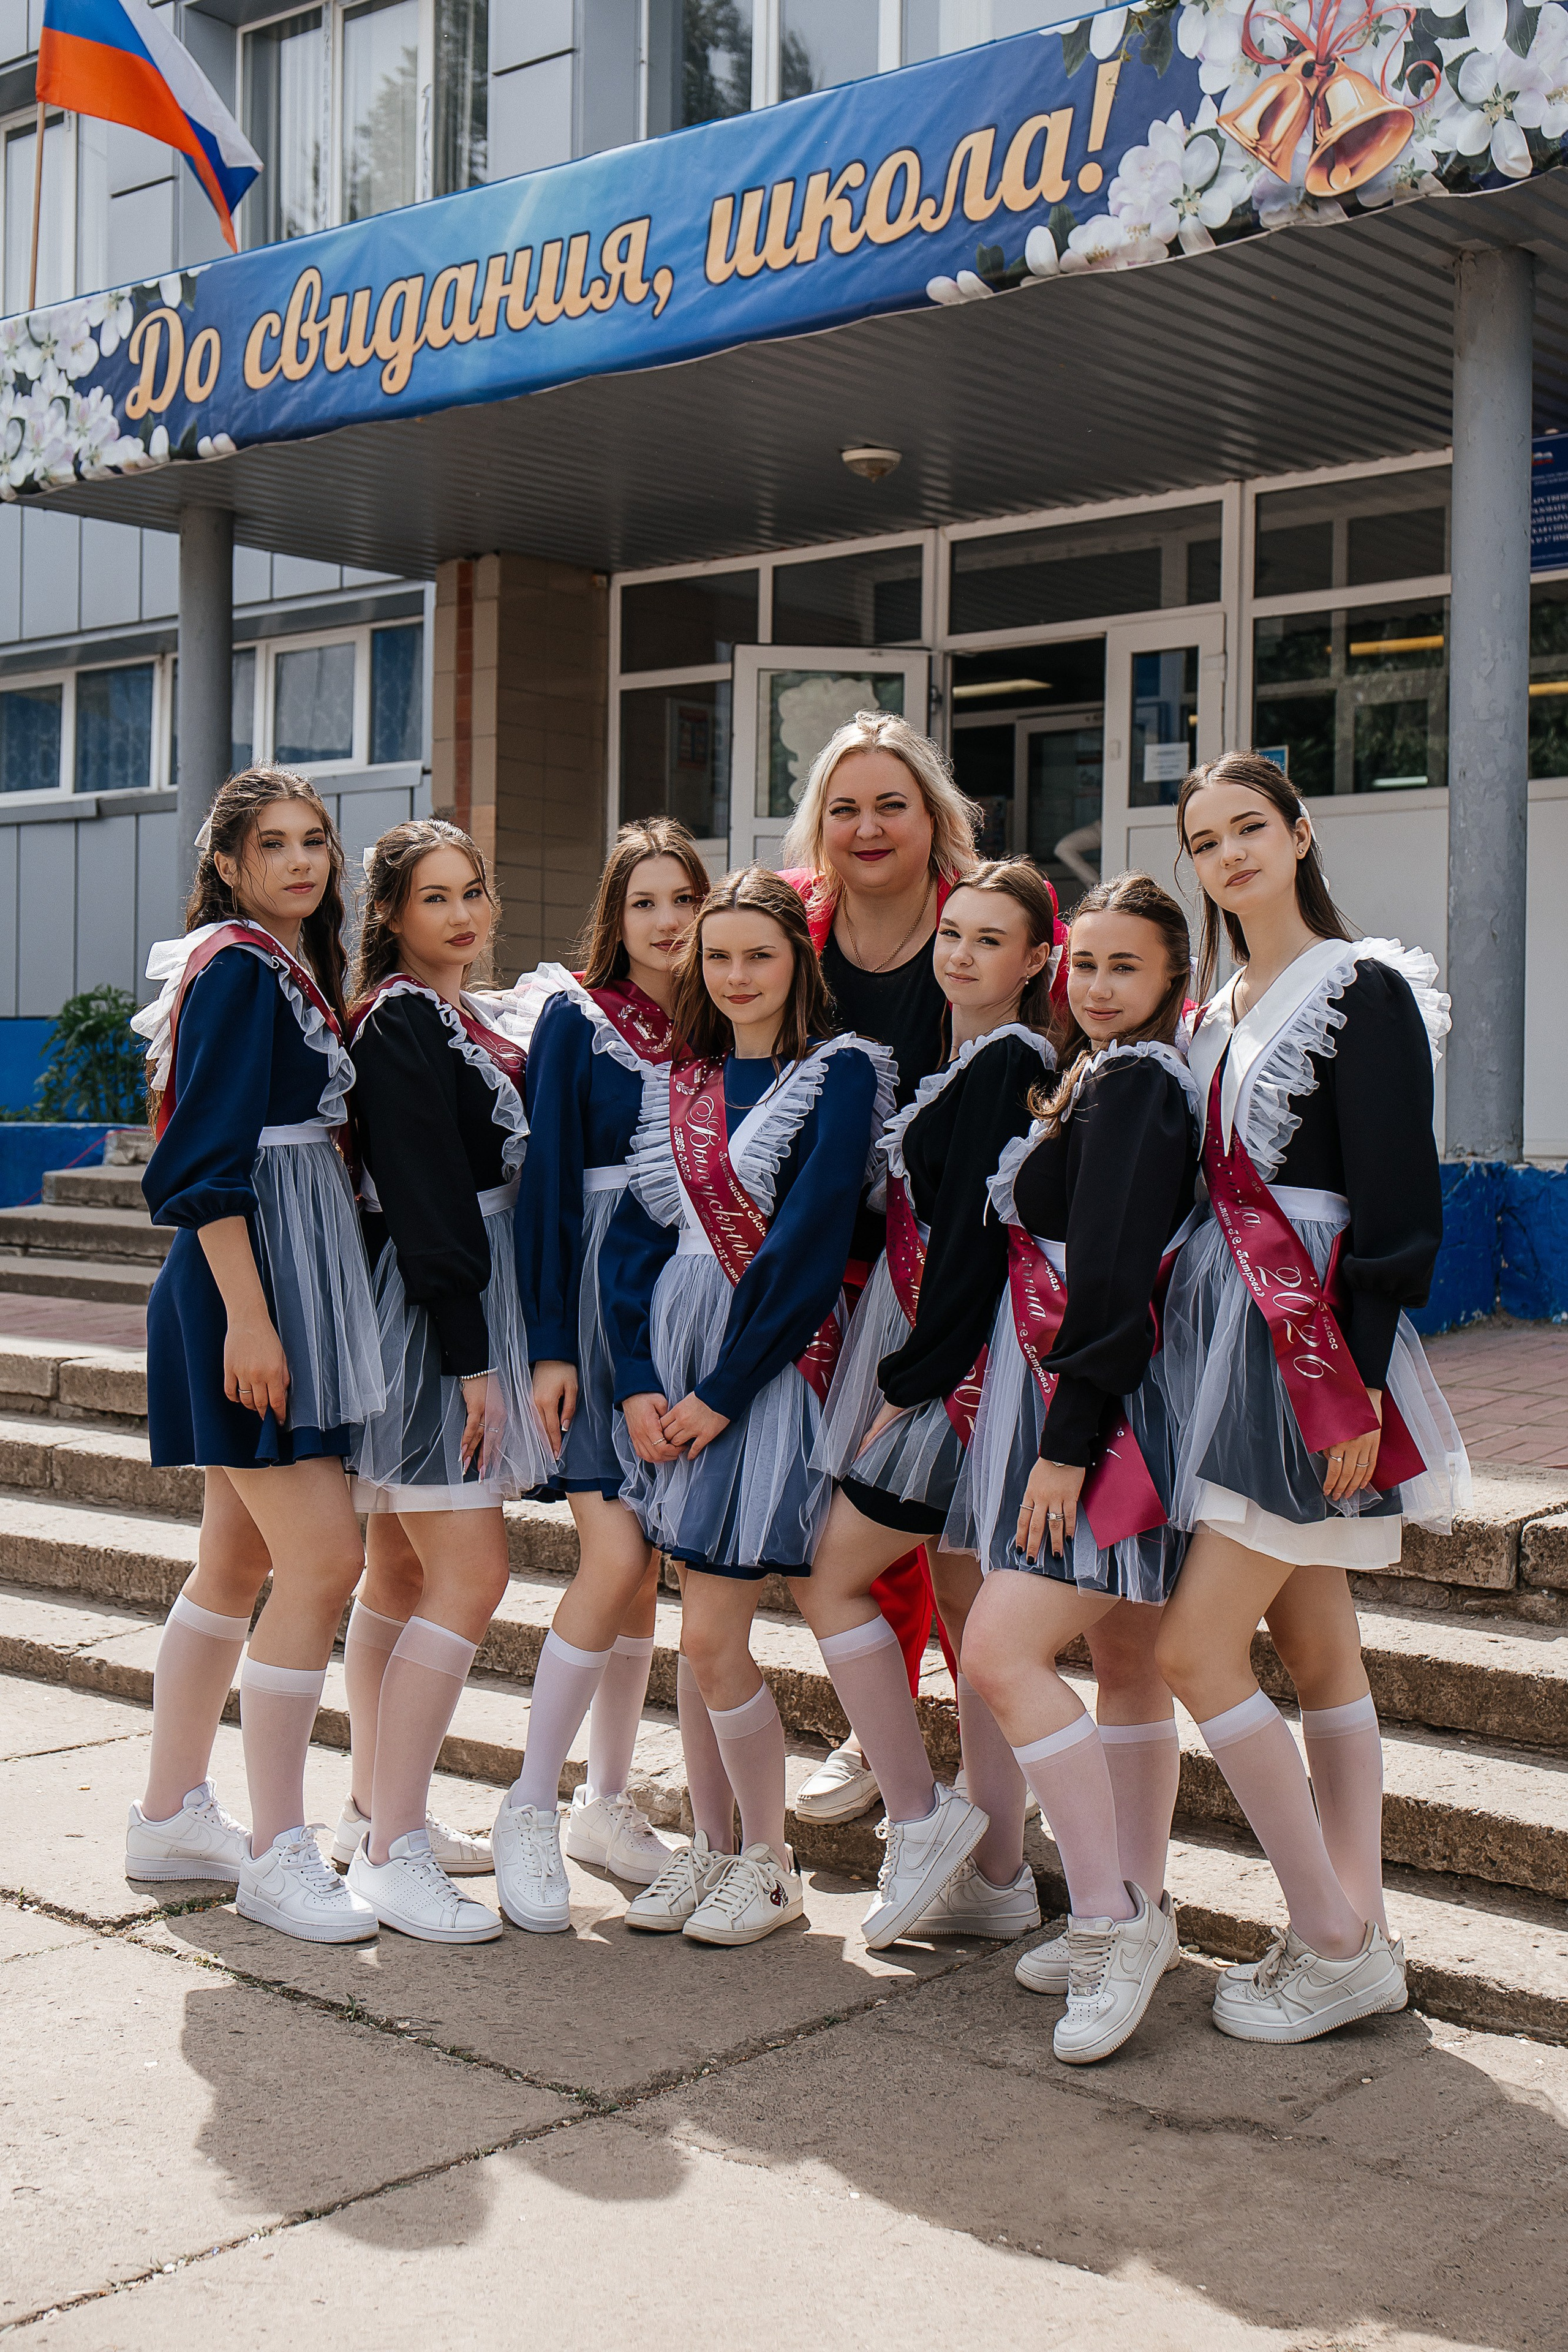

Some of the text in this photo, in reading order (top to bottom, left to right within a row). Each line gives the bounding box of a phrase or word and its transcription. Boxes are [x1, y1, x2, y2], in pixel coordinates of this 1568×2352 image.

[125, 59, 1122, 420] До свидания, школа!
[673, 1126, 686, 1152] ГБОУ
[718, 1151, 750, 1210] Анастасия
[1218, 1200, 1232, 1227] имени
[1236, 1251, 1265, 1297] Петрова»
[1256, 1266, 1338, 1379] 2026
[1322, 1316, 1338, 1350] класс
[1023, 1343, 1052, 1393] Петрова»
